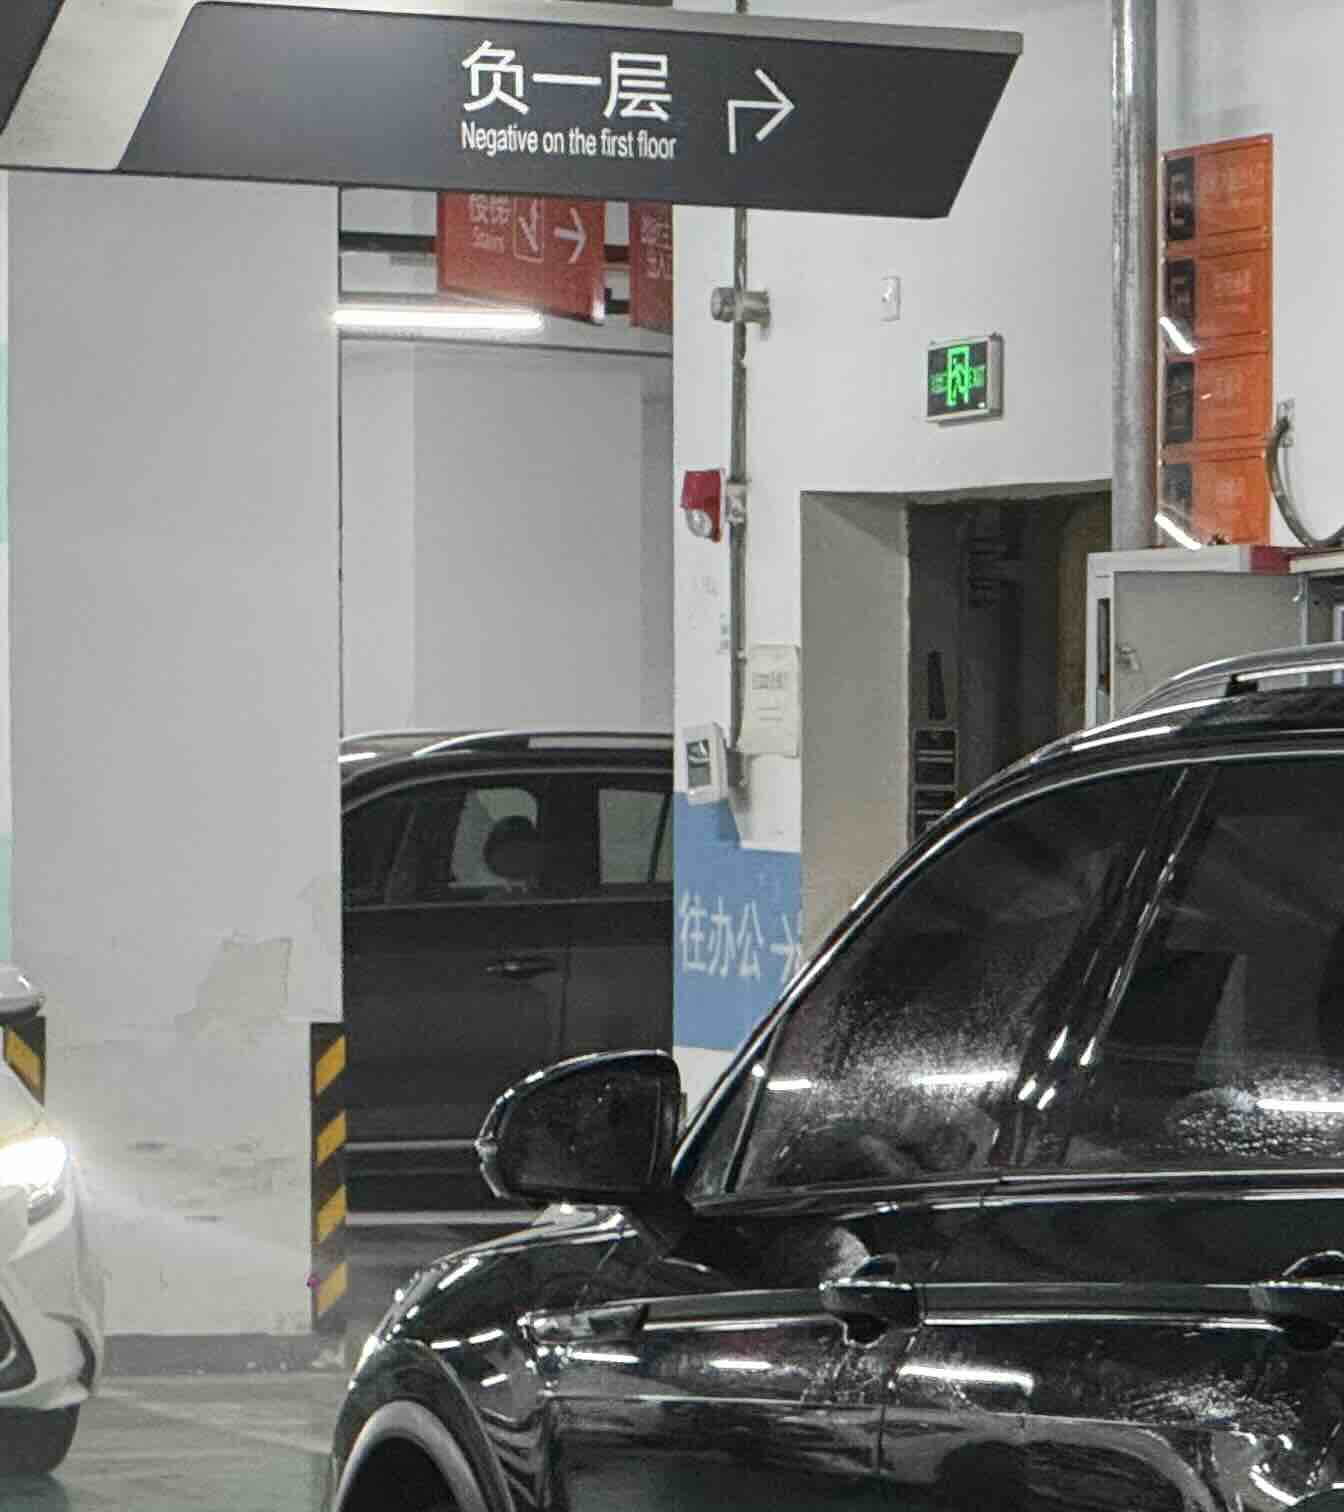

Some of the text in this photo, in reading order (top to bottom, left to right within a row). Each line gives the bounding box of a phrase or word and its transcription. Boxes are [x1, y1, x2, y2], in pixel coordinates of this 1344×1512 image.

[461, 39, 673, 122] 负一层
[461, 120, 677, 160] Negative on the first floor
